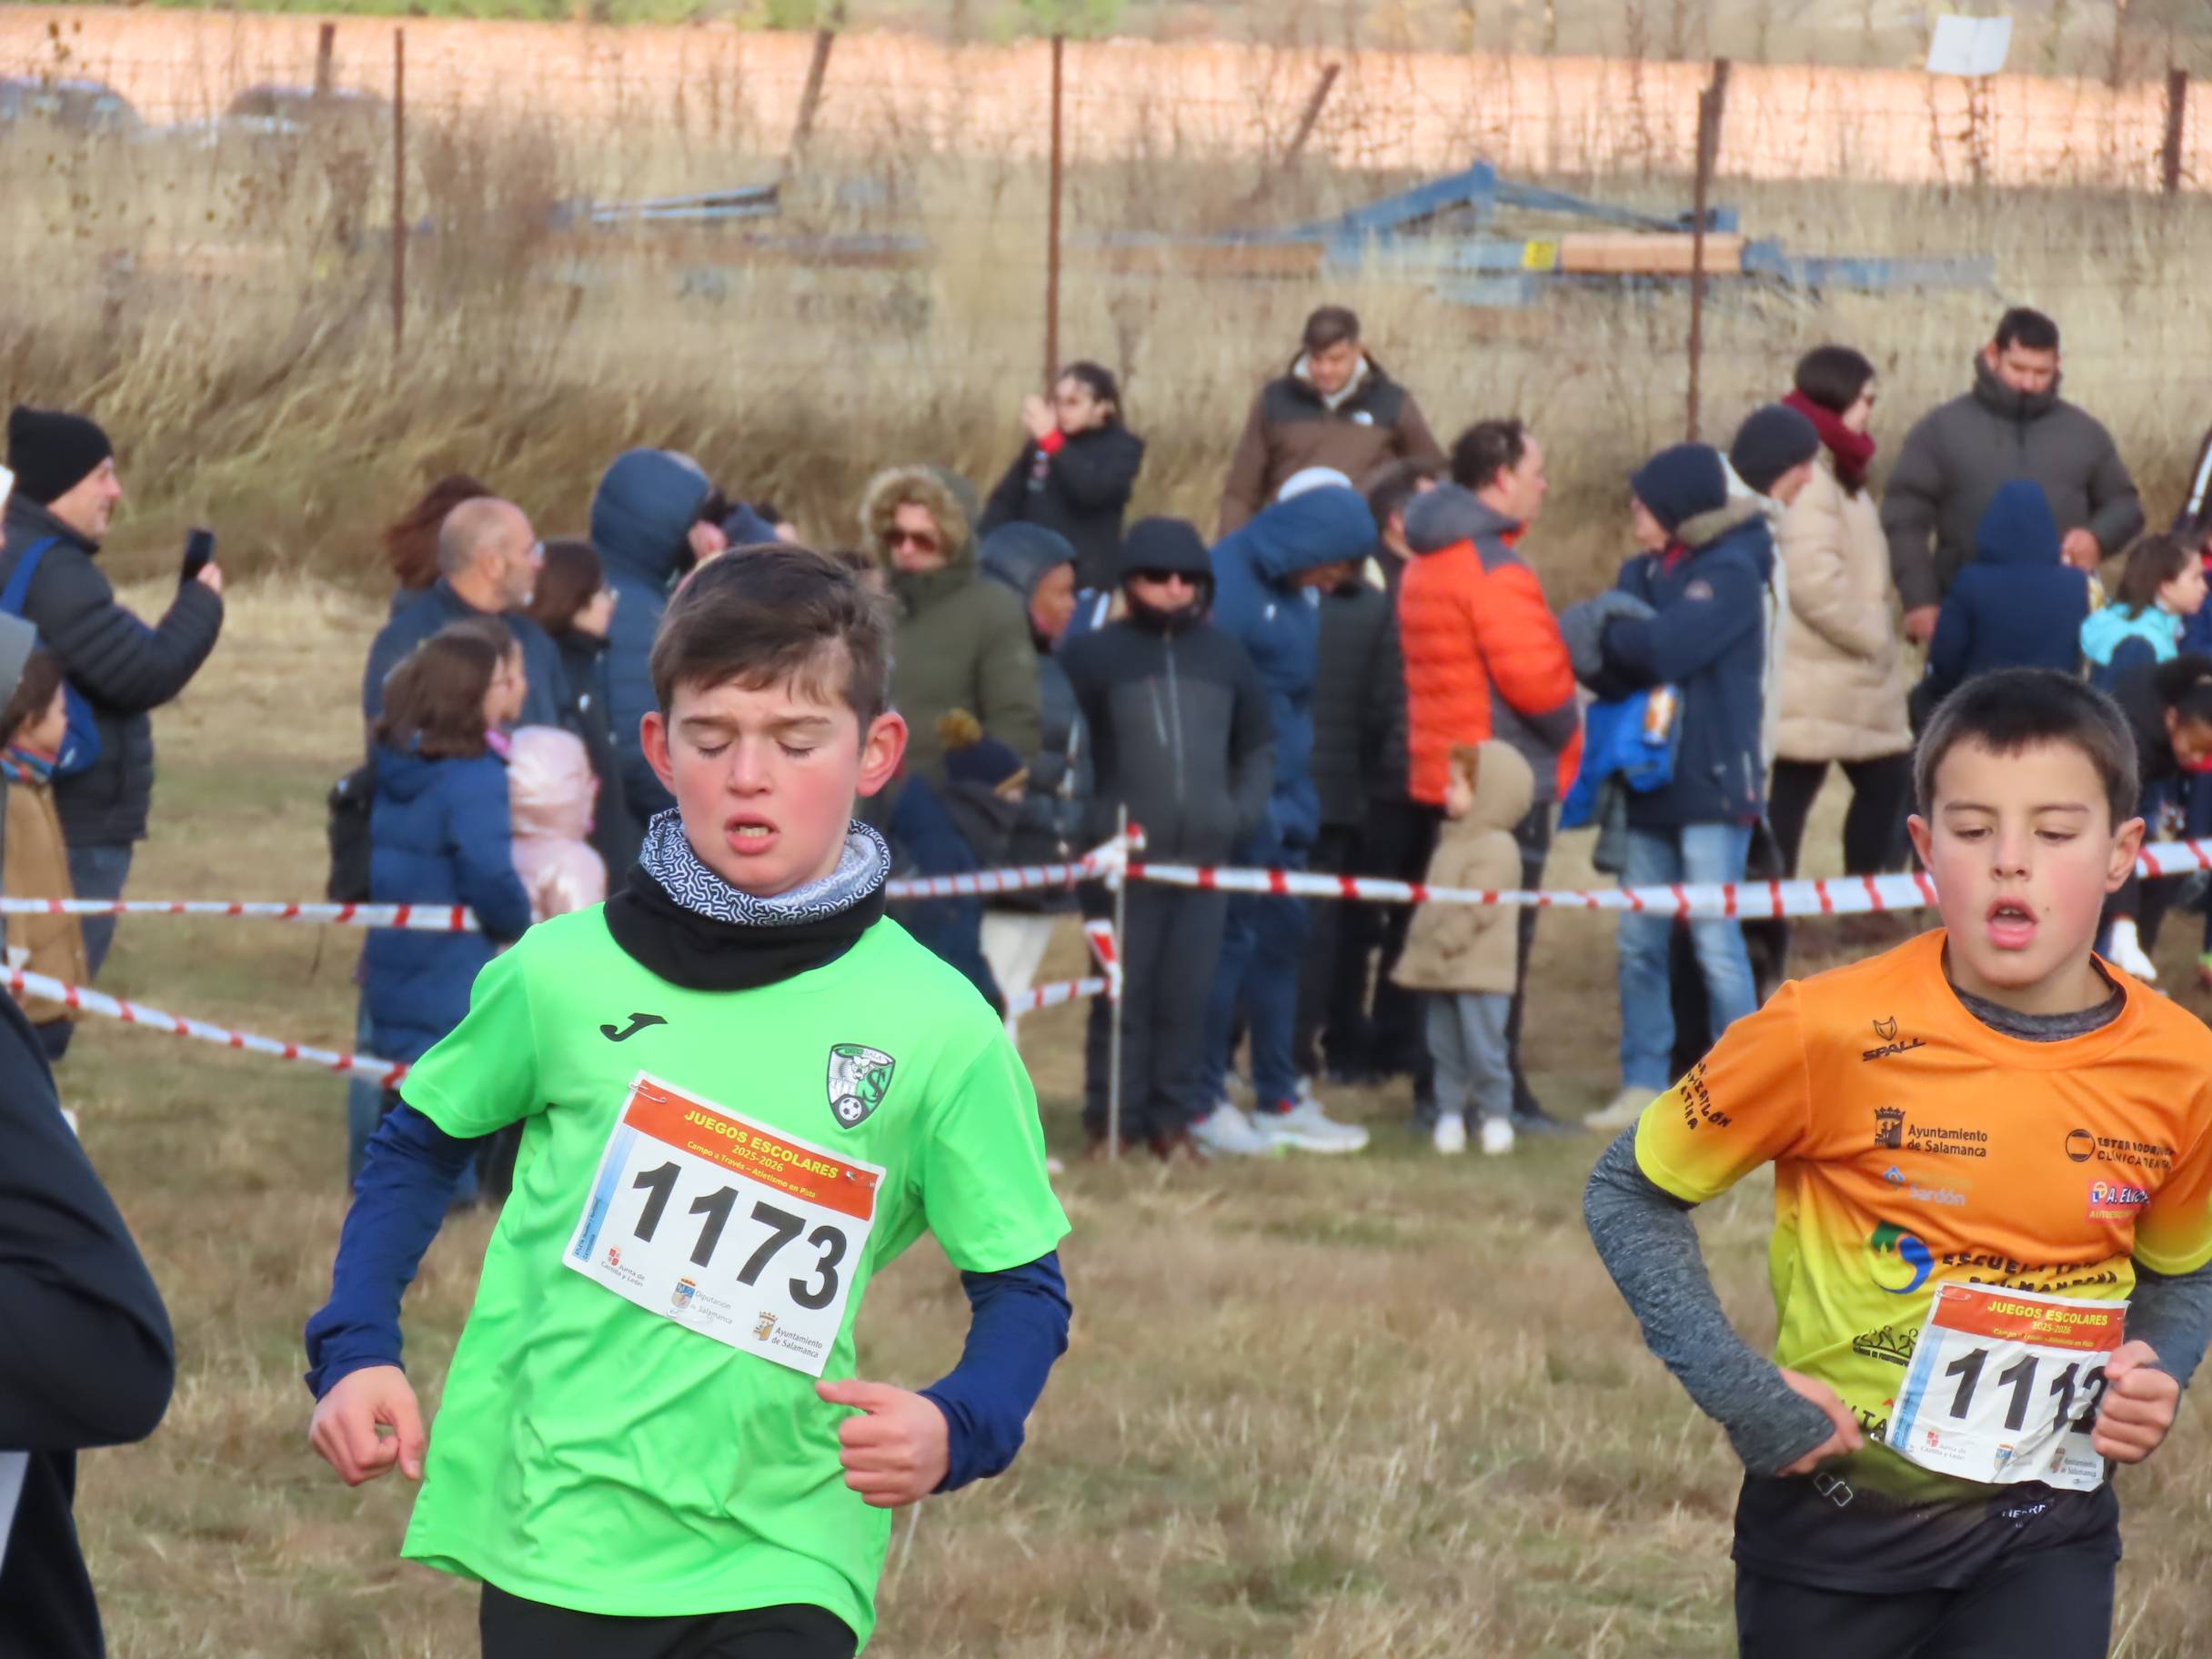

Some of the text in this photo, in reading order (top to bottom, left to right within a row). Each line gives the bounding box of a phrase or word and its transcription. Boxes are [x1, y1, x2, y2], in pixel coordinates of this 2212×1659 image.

[1908, 1124, 1987, 1141] Ayuntamiento
[684, 1110, 839, 1179] JUEGOS ESCOLARES
[1907, 1140, 1986, 1157] de Salamanca
[687, 1141, 713, 1158] Campo
[720, 1154, 745, 1171] Través
[751, 1168, 788, 1188] Atletismo
[789, 1184, 799, 1193] en
[731, 1144, 784, 1172] 2025-2026
[632, 1161, 848, 1311] 1173
[601, 1261, 622, 1278] Castilla
[627, 1275, 643, 1287] León
[618, 1262, 646, 1281] Junta de
[695, 1290, 732, 1310] Diputación
[698, 1306, 733, 1325] Salamanca
[1987, 1301, 2108, 1326] JUEGOS ESCOLARES
[771, 1336, 819, 1359] de Salamanca
[775, 1326, 823, 1349] Ayuntamiento
